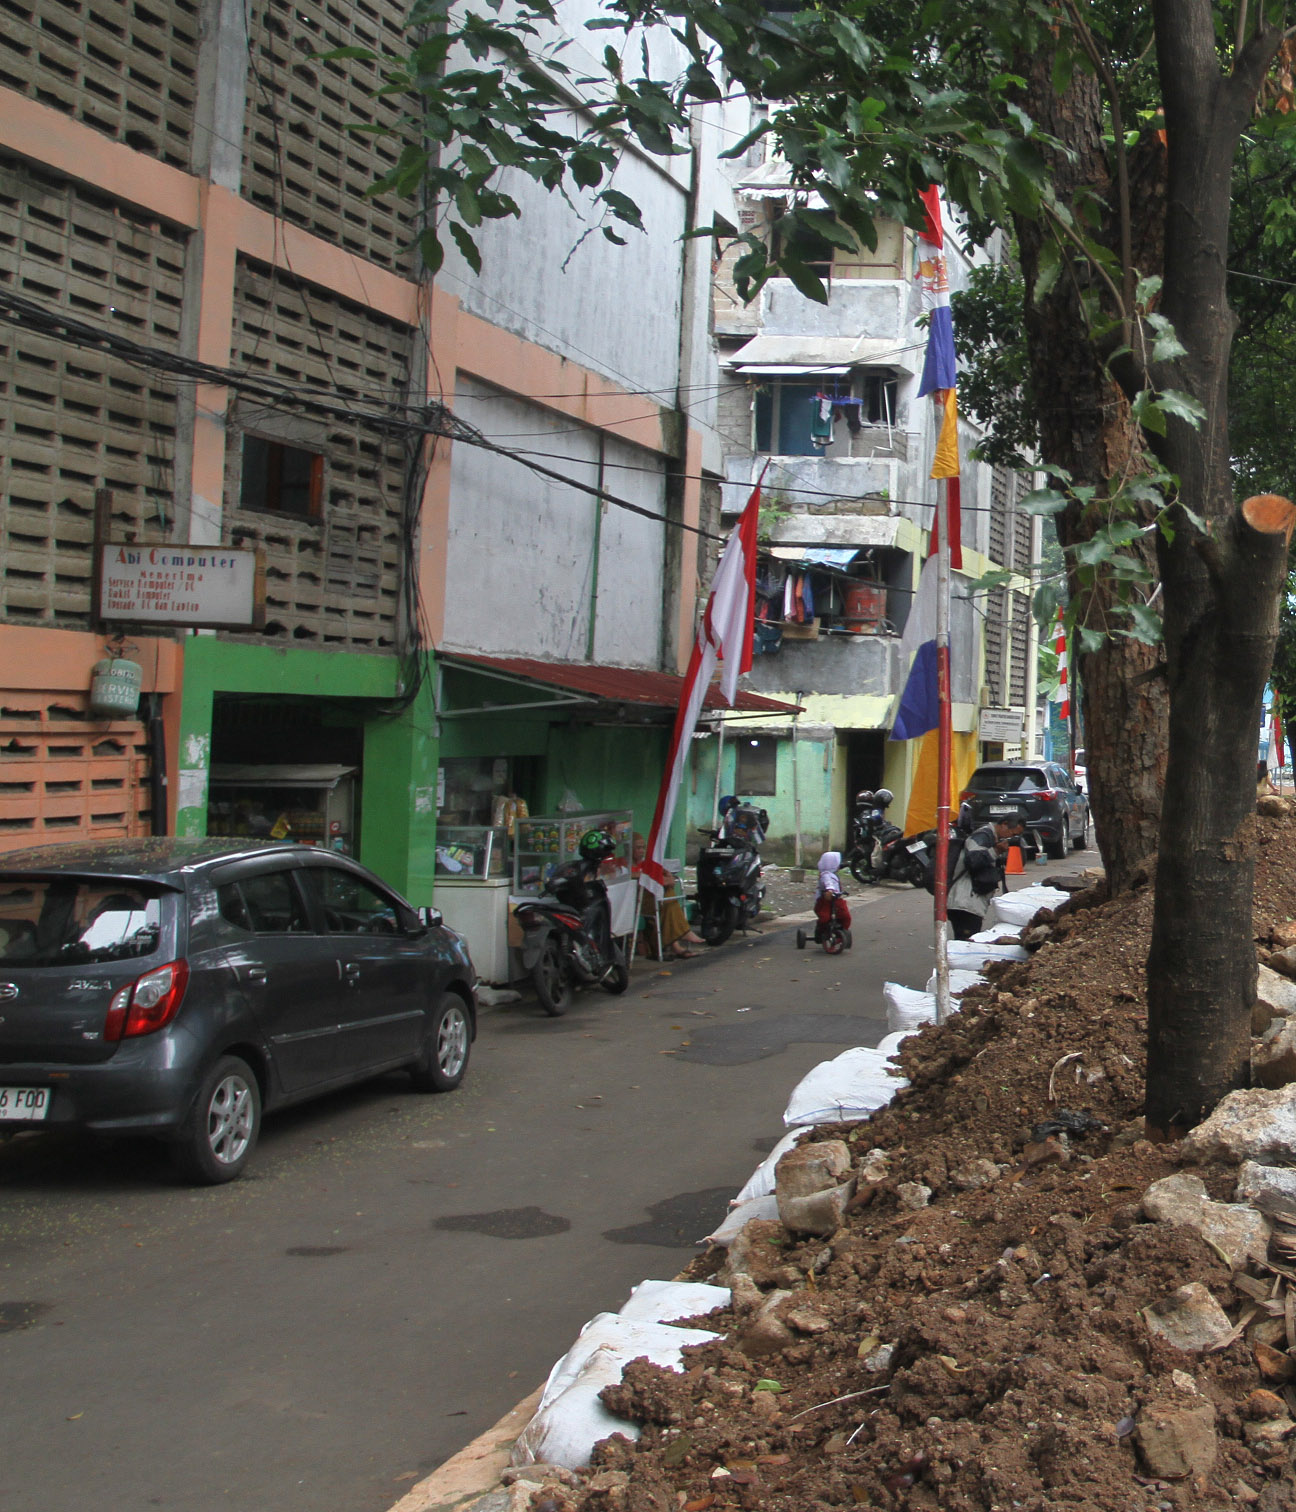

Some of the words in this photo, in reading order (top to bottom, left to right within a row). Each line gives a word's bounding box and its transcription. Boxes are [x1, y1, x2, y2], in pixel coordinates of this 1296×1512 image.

[115, 548, 141, 565] Abi
[150, 549, 237, 569] Computer
[140, 570, 203, 582] Menerima
[108, 577, 135, 588] Service
